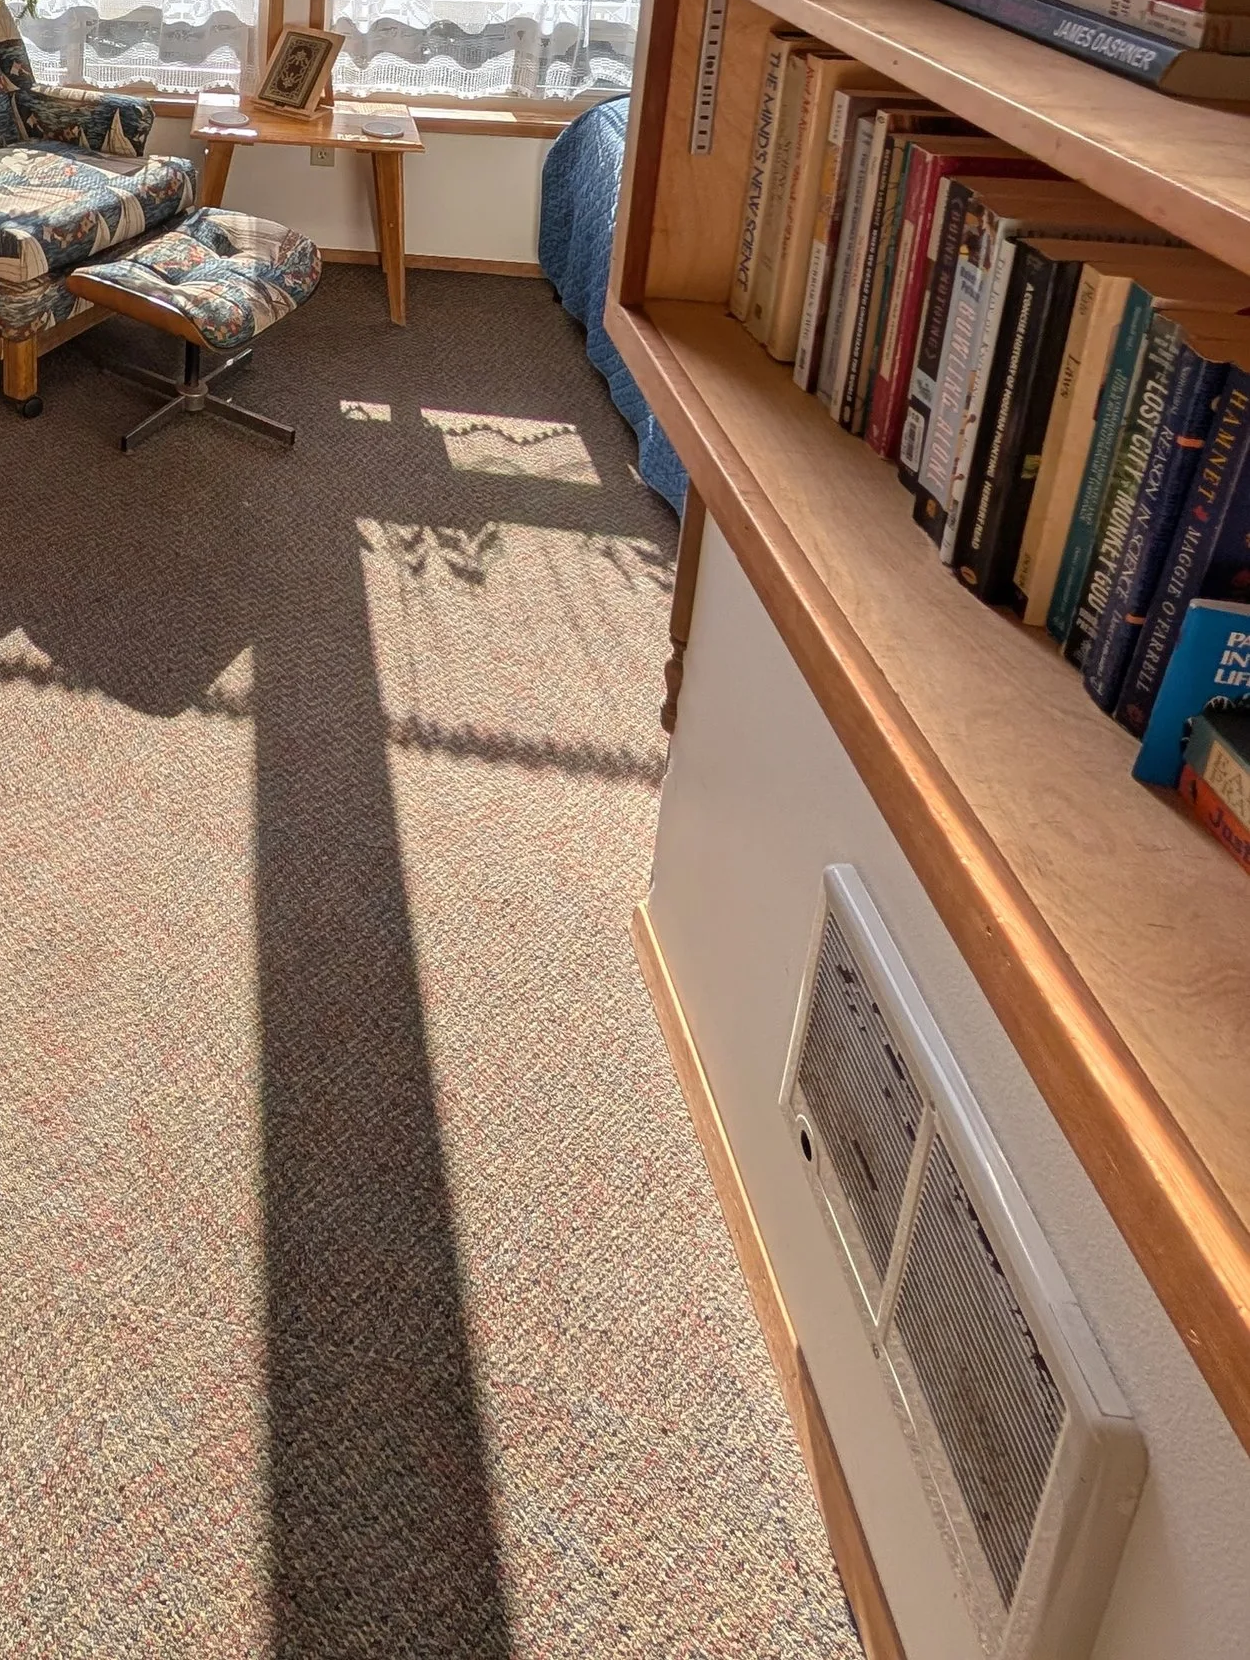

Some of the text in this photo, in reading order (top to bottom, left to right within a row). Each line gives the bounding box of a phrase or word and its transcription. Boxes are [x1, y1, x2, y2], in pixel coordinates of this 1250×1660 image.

[1052, 19, 1156, 71] JAMES DASHNER
[764, 50, 783, 90] THE
[744, 166, 766, 216] NEW
[733, 218, 759, 292] SCIENCE
[1015, 292, 1033, 333] CONCISE
[941, 298, 978, 417] BOWLING
[1006, 333, 1024, 376] HISTORY
[1058, 353, 1081, 400] Laws
[845, 372, 856, 401] WORLD
[1004, 375, 1015, 389] OF
[1134, 380, 1167, 429] LOST
[994, 388, 1012, 431] MODERN
[925, 420, 955, 491] ALONE
[985, 430, 1003, 477] PAINTING
[1121, 434, 1152, 479] CITY
[1141, 425, 1175, 500] REASON
[975, 480, 993, 523] HERBERT
[1134, 503, 1153, 527] IN
[970, 523, 984, 549] READ
[1097, 490, 1136, 568] MONKEY
[1136, 389, 1249, 693] HAMNET MAGGIE O'FARRELL
[1112, 532, 1146, 603] SCIENCE
